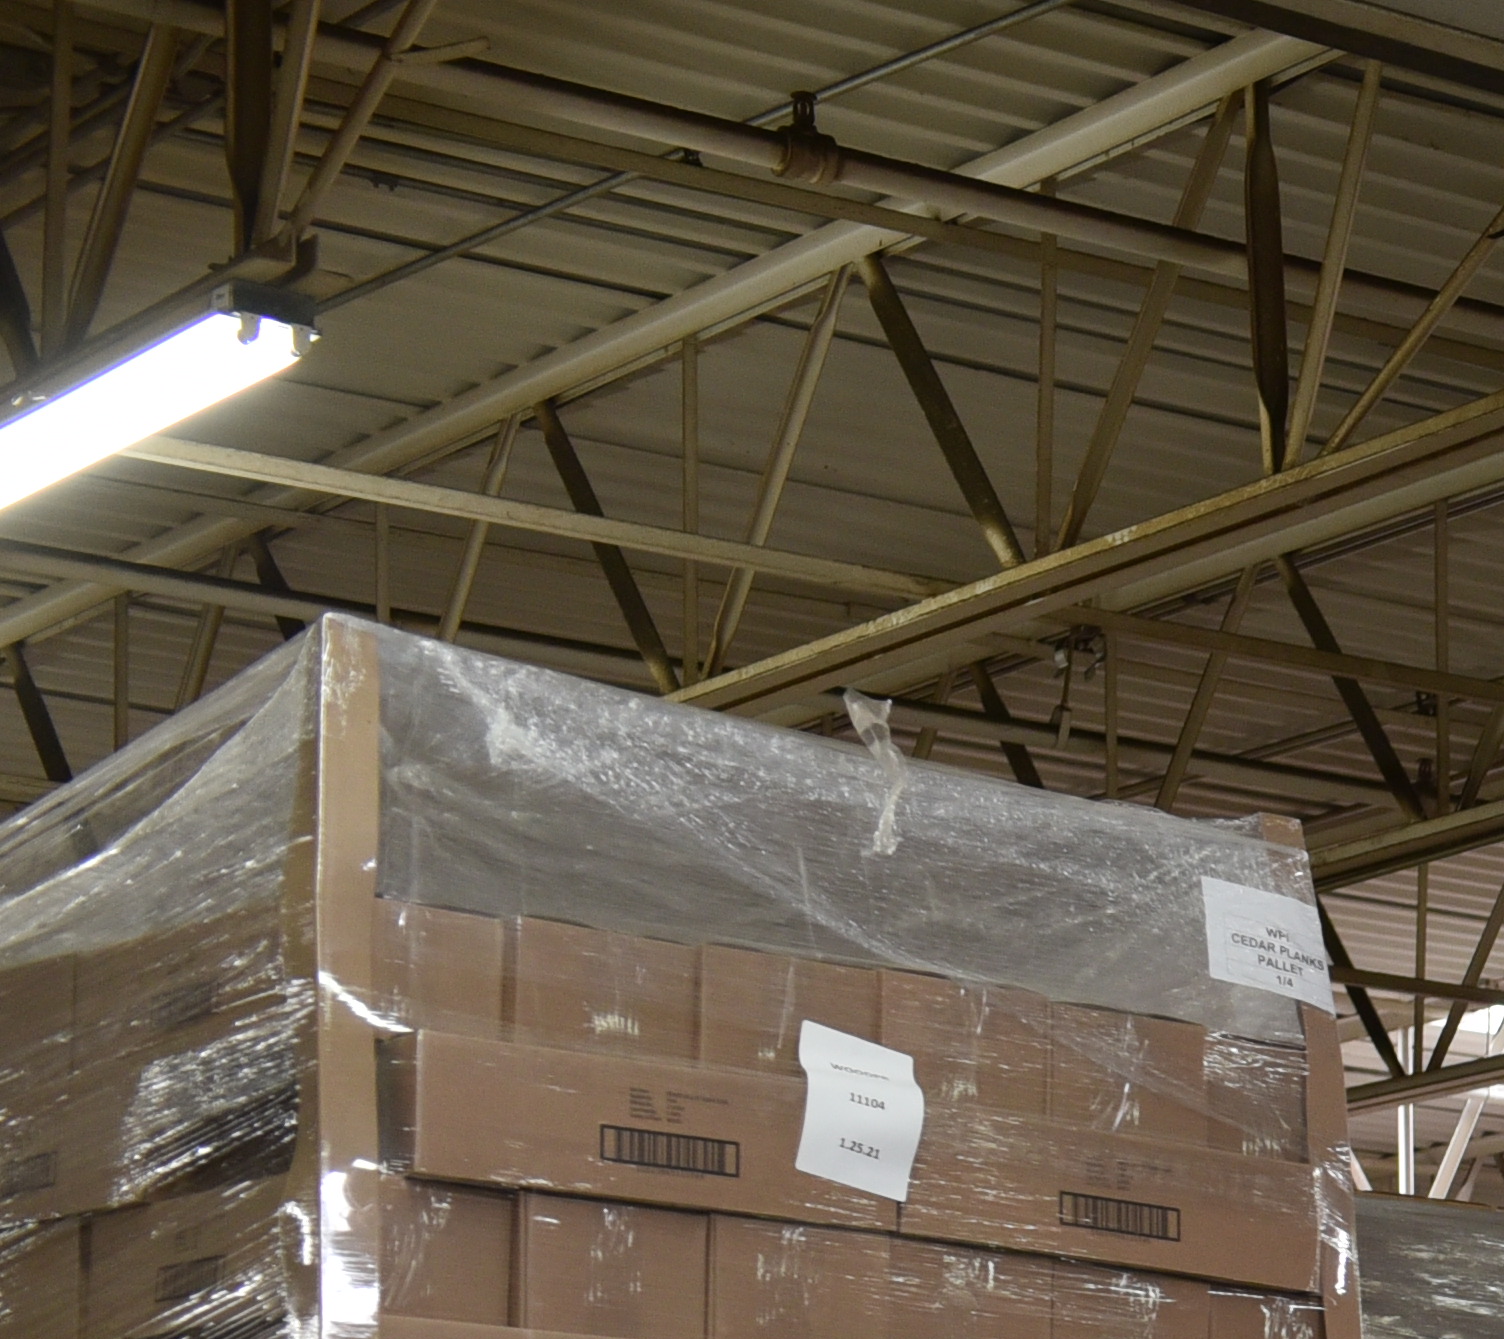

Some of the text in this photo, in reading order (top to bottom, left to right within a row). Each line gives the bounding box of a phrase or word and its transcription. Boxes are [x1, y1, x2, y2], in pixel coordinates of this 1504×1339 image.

[1232, 933, 1325, 971] CEDAR PLANKS
[1258, 954, 1304, 976] PALLET
[1276, 975, 1293, 987] 1/4
[849, 1092, 885, 1110] 11104
[839, 1138, 880, 1159] 1.25.21
